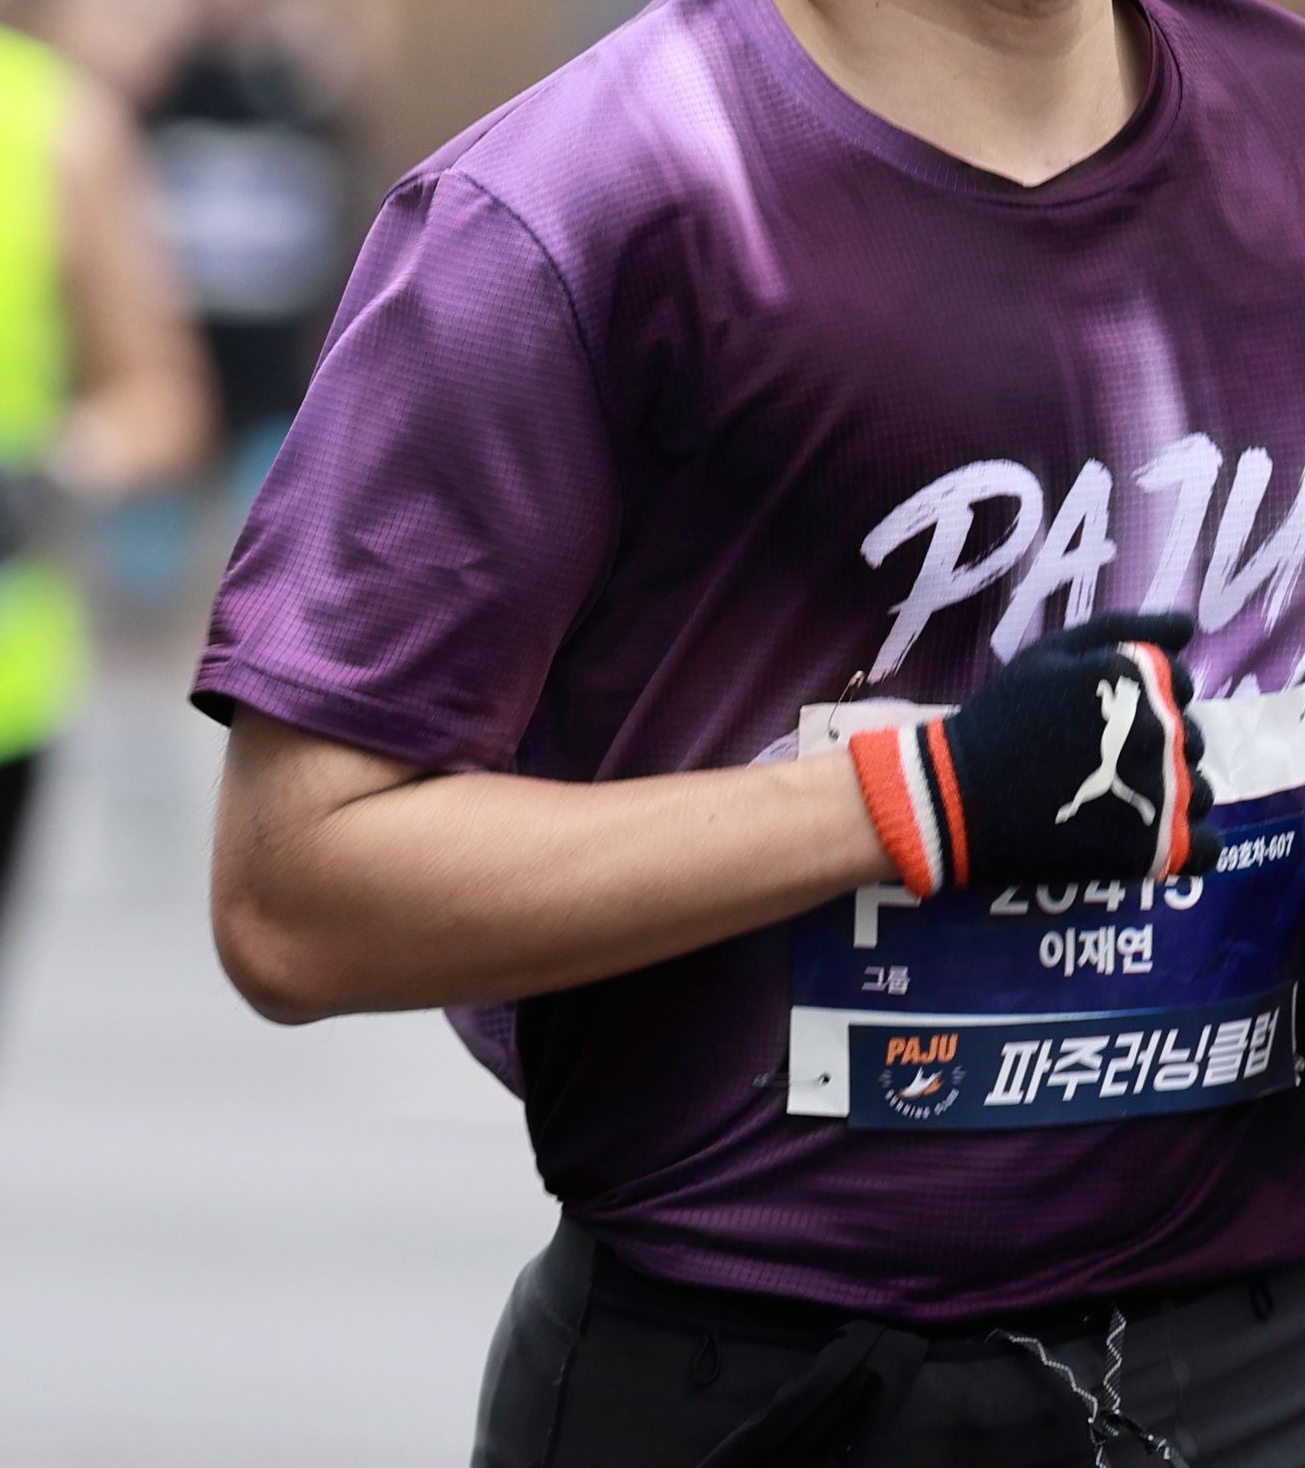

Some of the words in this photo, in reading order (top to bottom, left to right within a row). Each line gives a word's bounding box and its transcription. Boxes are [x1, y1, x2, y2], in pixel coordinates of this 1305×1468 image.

[1038, 923, 1154, 978] 이재연
[861, 965, 911, 995] 그룹
[885, 1032, 959, 1067] PAJU
[983, 1006, 1280, 1106] 파주러닝클럽
